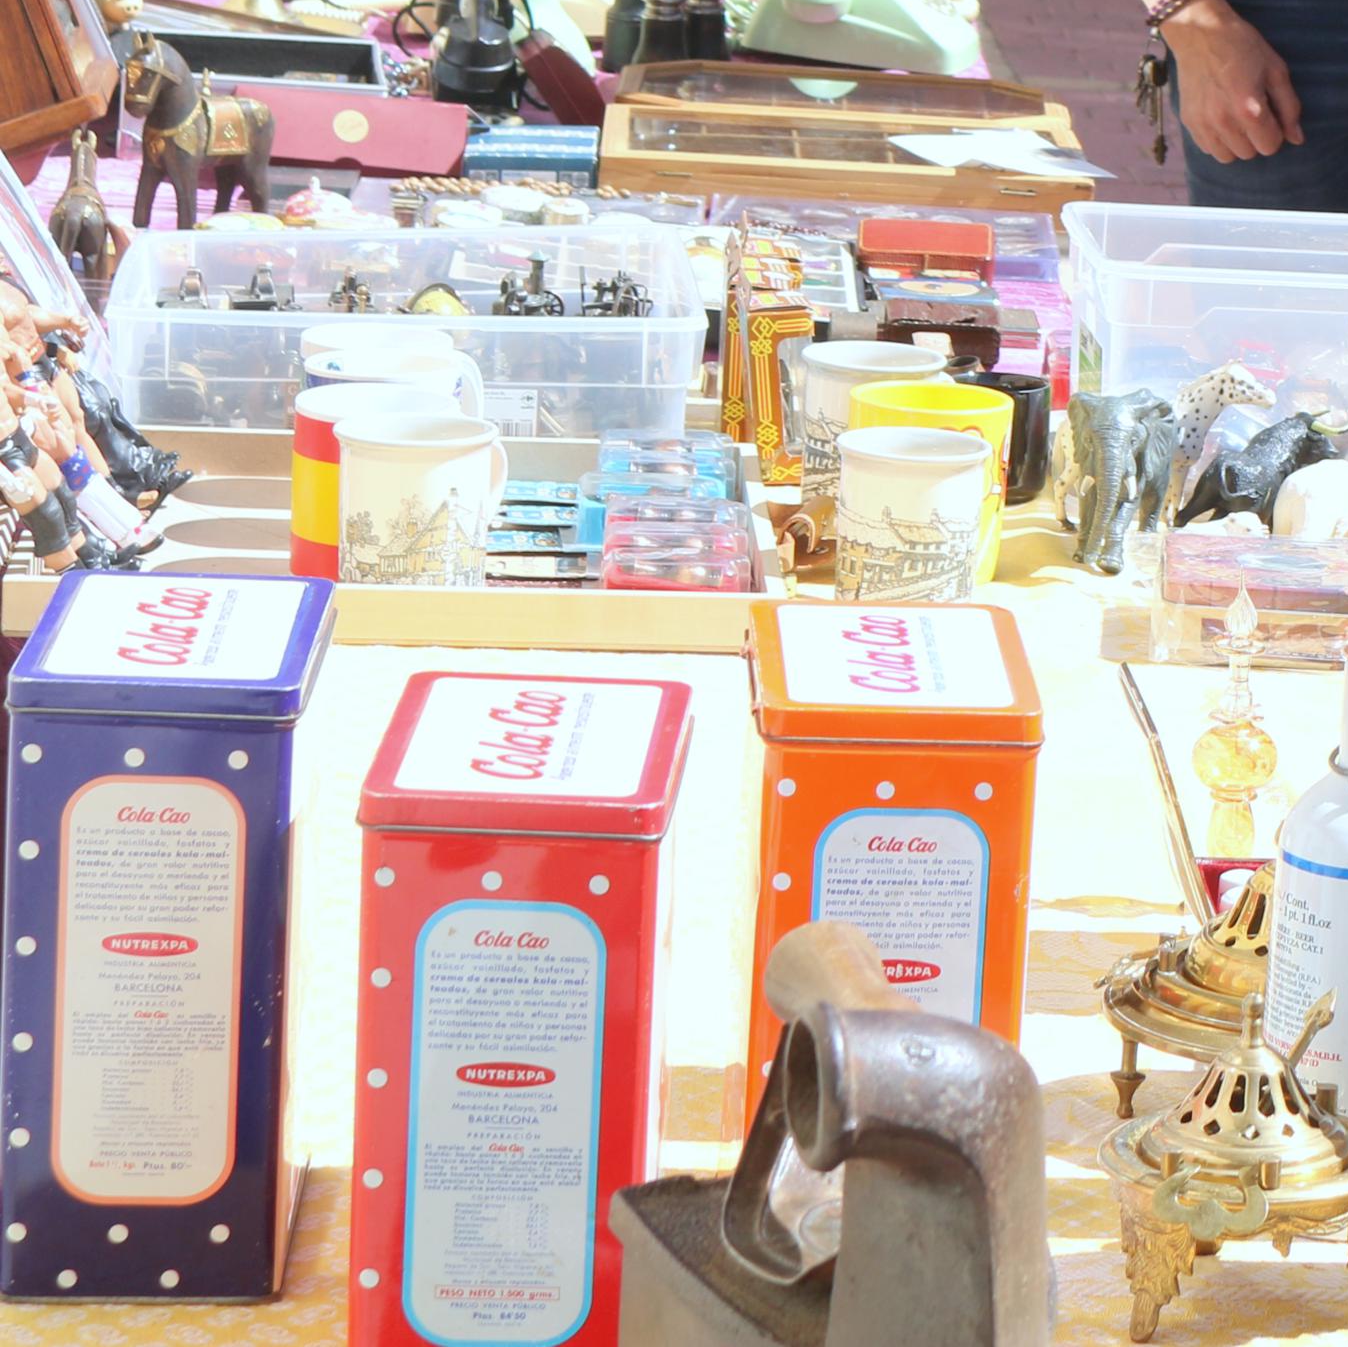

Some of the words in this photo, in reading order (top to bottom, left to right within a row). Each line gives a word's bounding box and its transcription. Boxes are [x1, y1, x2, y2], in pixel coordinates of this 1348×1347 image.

[117, 806, 156, 823] Cola
[159, 807, 191, 824] Cao
[868, 835, 904, 852] Cola
[907, 836, 938, 853] Cao
[1286, 893, 1309, 911] Cont.
[111, 939, 189, 950] NUTREXPA
[474, 930, 514, 948] Cola
[517, 931, 550, 949] Cao
[114, 984, 183, 993] BARCELONA
[465, 1068, 546, 1081] NUTREXPA
[468, 1115, 539, 1125] BARCELONA
[439, 1289, 464, 1297] PESO
[469, 1289, 495, 1297] NETO
